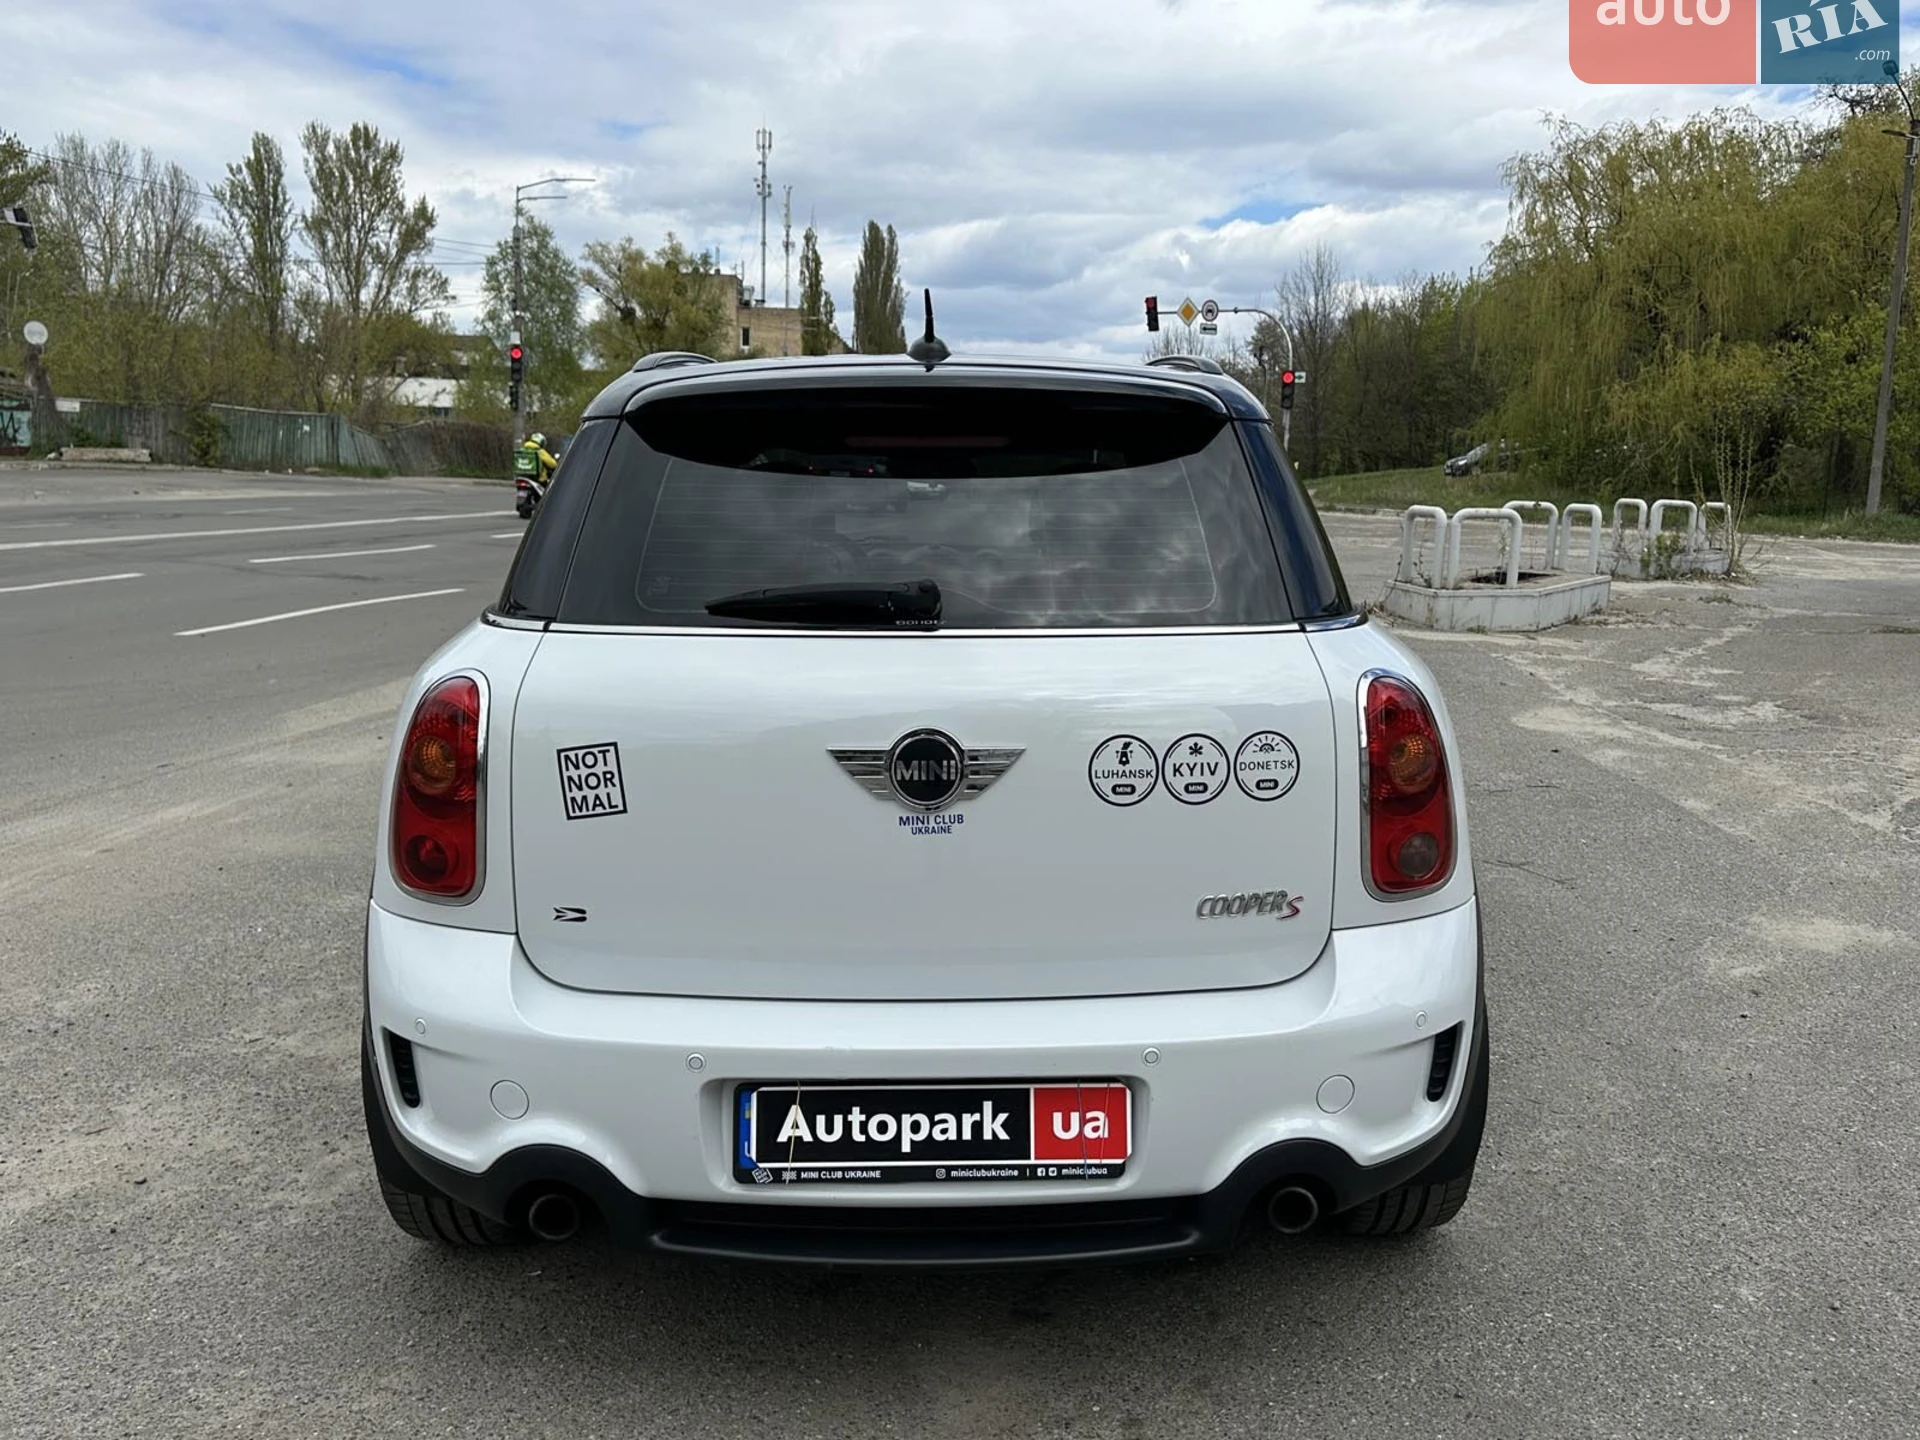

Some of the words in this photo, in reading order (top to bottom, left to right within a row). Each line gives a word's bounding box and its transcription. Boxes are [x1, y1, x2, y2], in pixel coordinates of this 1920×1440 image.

[563, 748, 611, 772] NOT
[1238, 759, 1295, 772] DONETSK
[895, 760, 956, 780] MINI
[1094, 768, 1154, 780] LUHANSK
[1172, 761, 1220, 778] KYIV
[566, 770, 617, 793] NOR
[569, 792, 619, 814] MAL
[898, 815, 930, 827] MINI
[934, 814, 965, 825] CLUB
[911, 825, 953, 836] UKRAINE
[1196, 890, 1288, 918] COOPER
[776, 1100, 1010, 1153] Autopark
[1052, 1109, 1109, 1140] ua
[800, 1171, 819, 1180] MINI
[820, 1170, 843, 1179] CLUB
[844, 1170, 882, 1178] UKRAINE
[950, 1168, 1019, 1178] miniclubukraine
